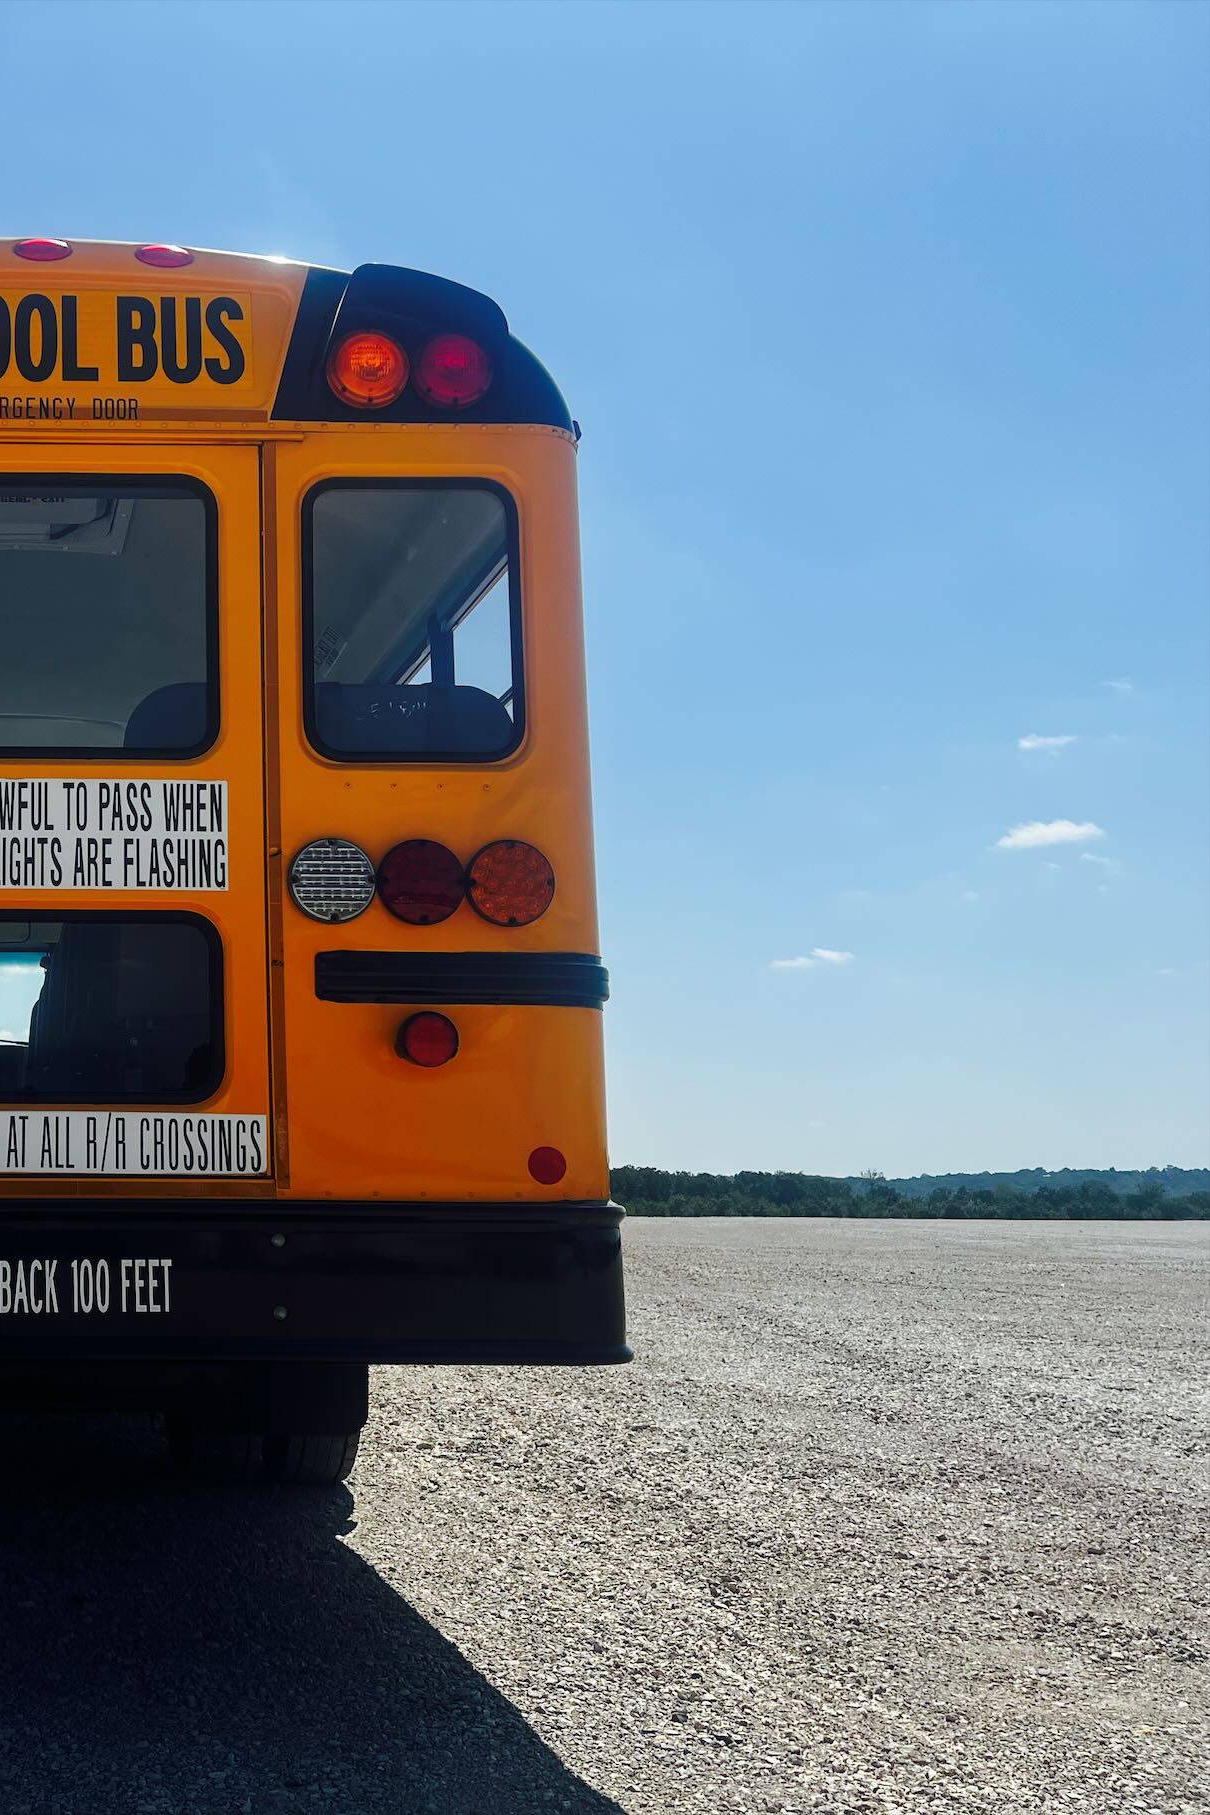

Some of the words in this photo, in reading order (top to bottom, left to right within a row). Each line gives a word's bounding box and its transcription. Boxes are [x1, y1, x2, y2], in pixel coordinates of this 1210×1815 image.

[117, 295, 246, 384] BUS
[93, 398, 139, 420] DOOR
[62, 782, 88, 831] TO
[99, 782, 152, 832] PASS
[163, 783, 223, 832] WHEN
[73, 838, 113, 887] ARE
[123, 838, 226, 888] FLASHING
[6, 1115, 29, 1168] AT
[40, 1116, 75, 1169] ALL
[86, 1112, 126, 1171] R/R
[140, 1117, 262, 1172] CROSSINGS
[71, 1259, 110, 1313] 100
[121, 1259, 172, 1313] FEET
